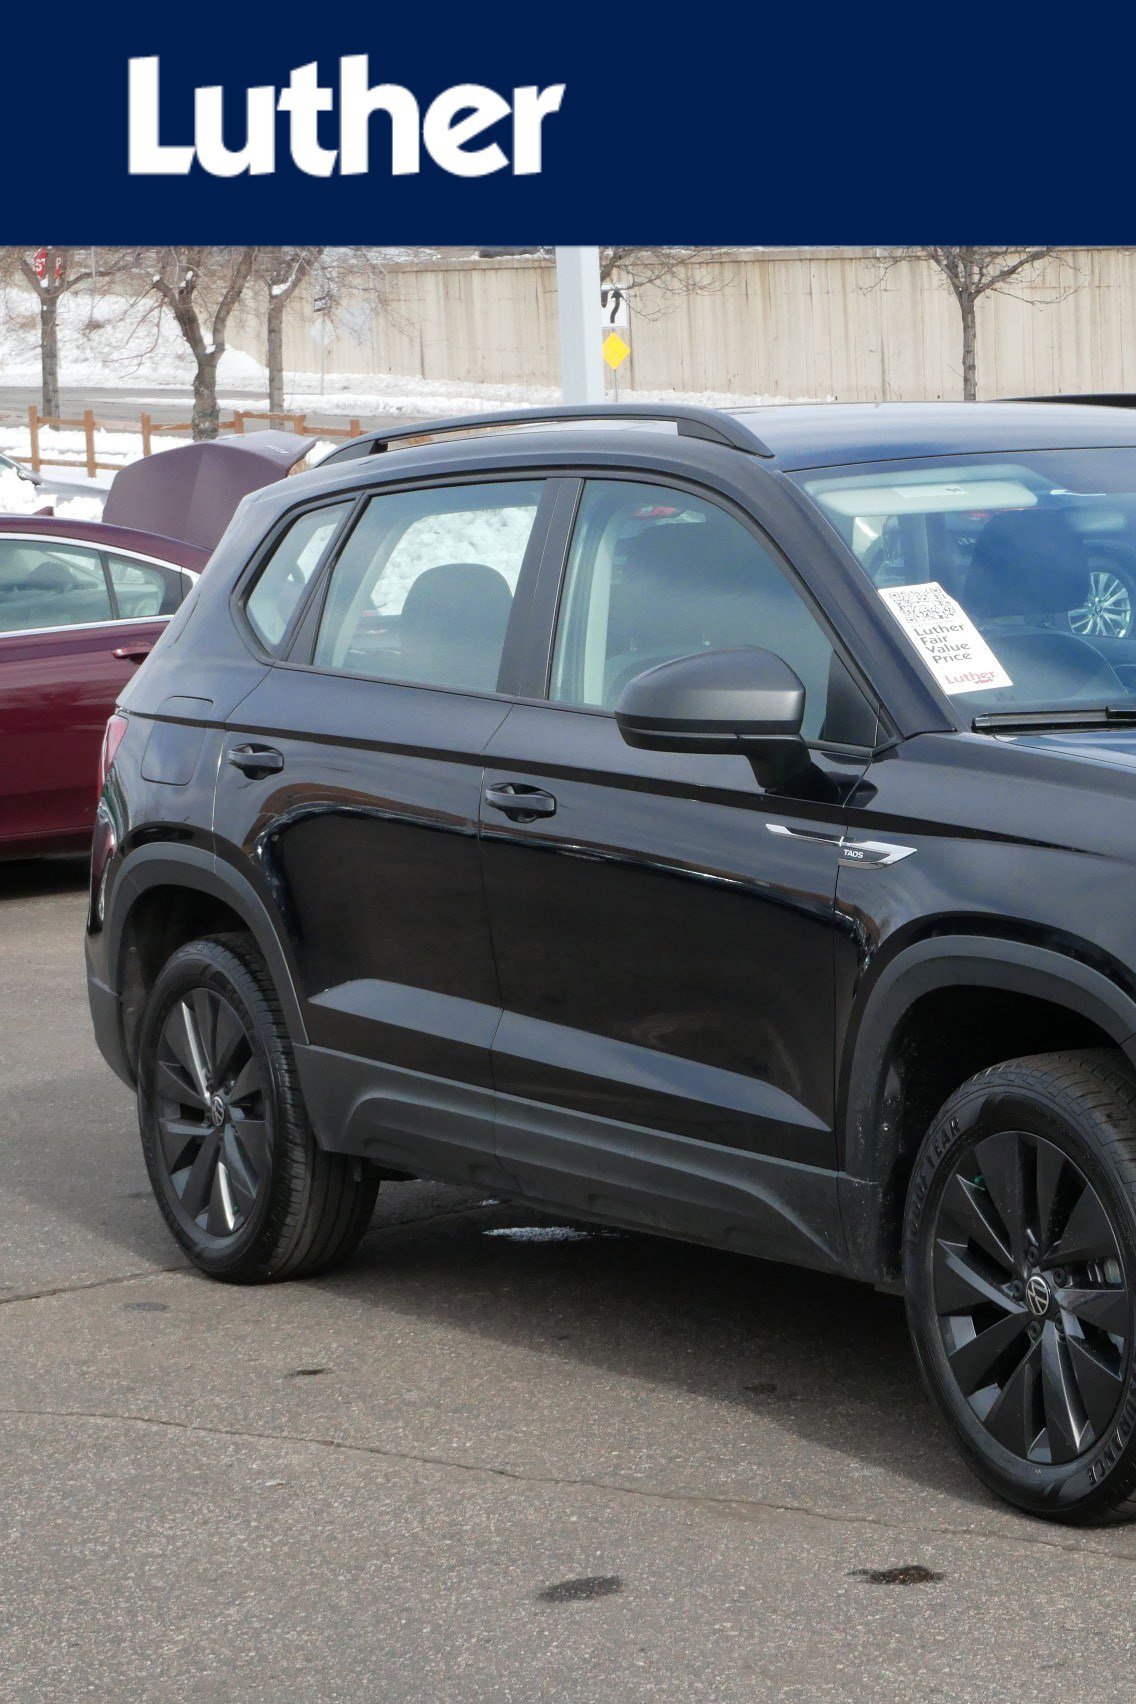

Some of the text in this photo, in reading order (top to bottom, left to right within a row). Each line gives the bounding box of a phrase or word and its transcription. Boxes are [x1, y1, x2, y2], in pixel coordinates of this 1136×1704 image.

[914, 624, 964, 637] Luther
[920, 635, 948, 646] Fair
[925, 643, 970, 654] Value
[932, 653, 973, 664] Price
[944, 671, 996, 684] Luther
[843, 849, 864, 859] TAOS
